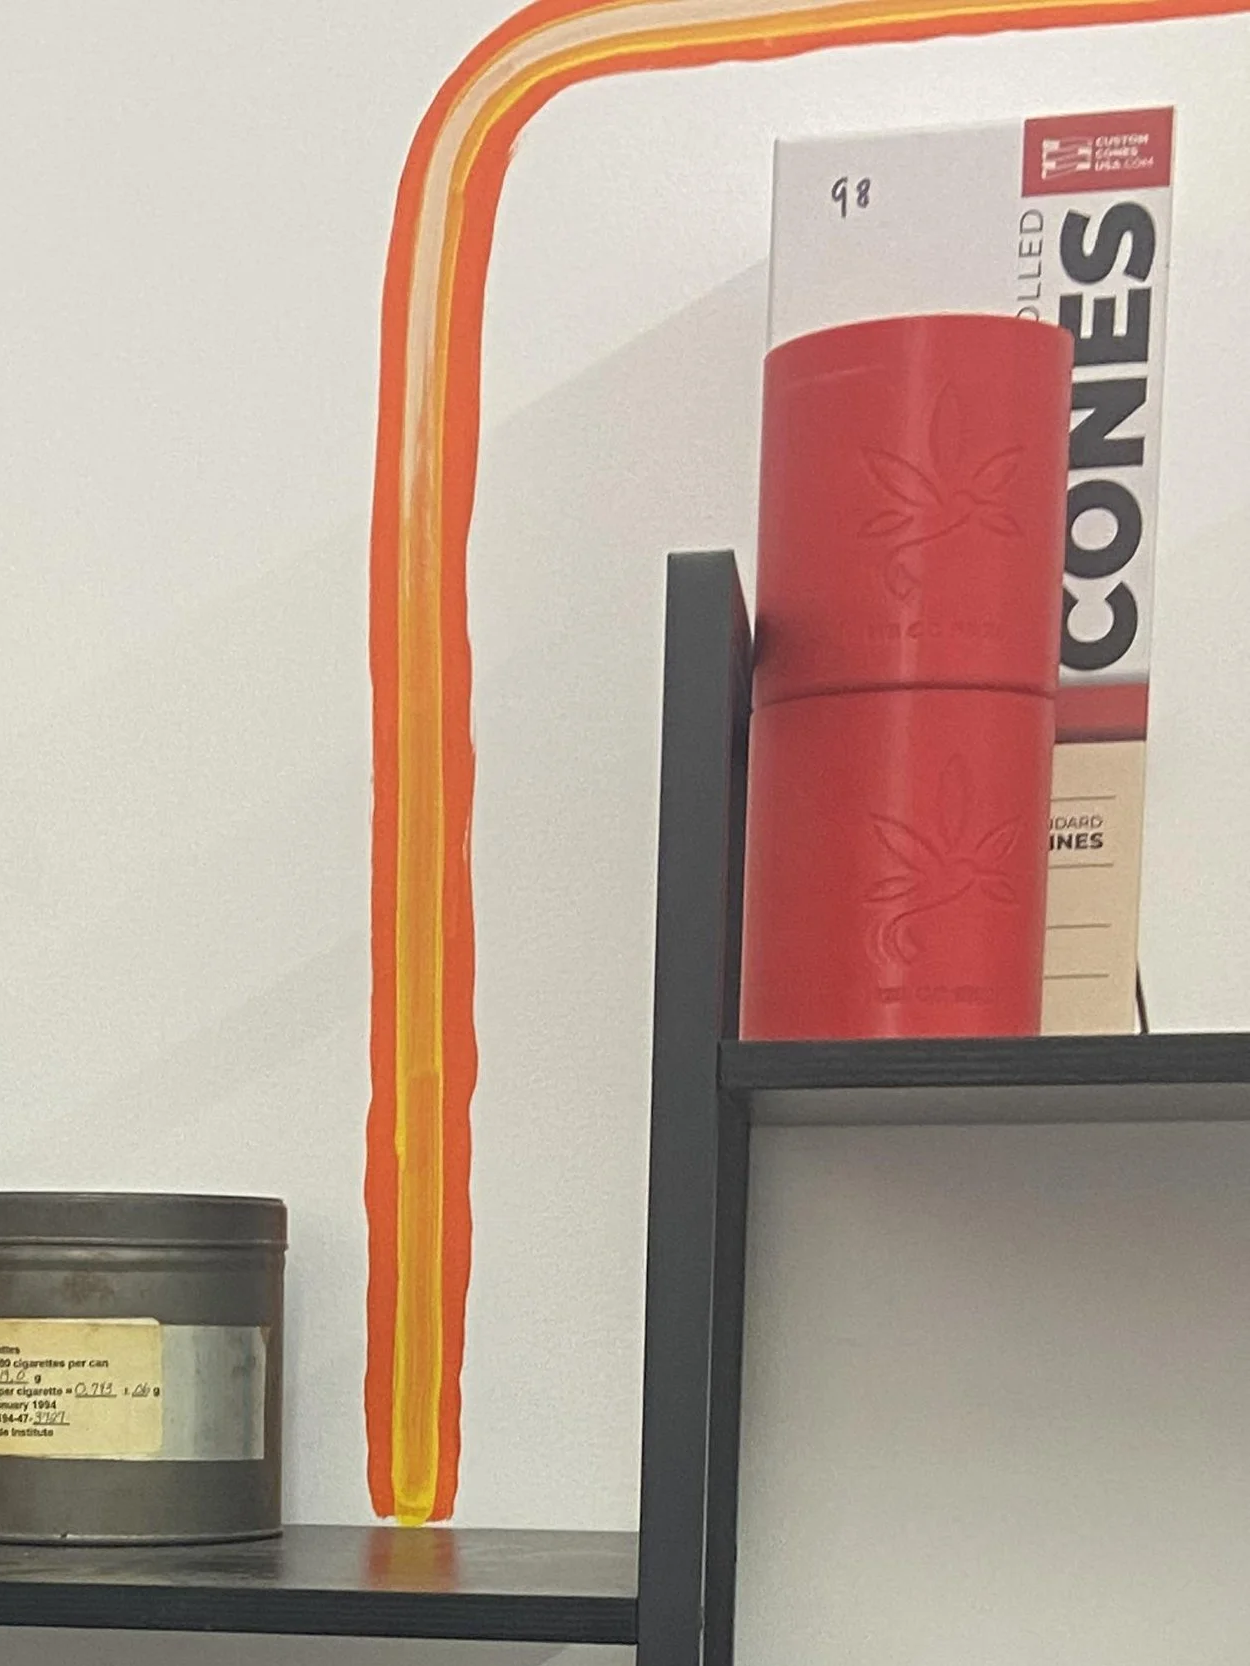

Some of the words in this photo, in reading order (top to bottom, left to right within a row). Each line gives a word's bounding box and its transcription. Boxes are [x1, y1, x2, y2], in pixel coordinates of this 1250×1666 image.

[1016, 208, 1044, 321] OLLED
[1059, 201, 1156, 672] CONES
[1049, 815, 1103, 830] DARD
[1050, 832, 1103, 850] NES
[13, 1359, 65, 1369] cigarettes
[68, 1360, 86, 1370] per
[88, 1360, 109, 1368] can
[16, 1386, 63, 1398] cigarette
[32, 1400, 57, 1410] 1994
[12, 1427, 53, 1437] Institute
